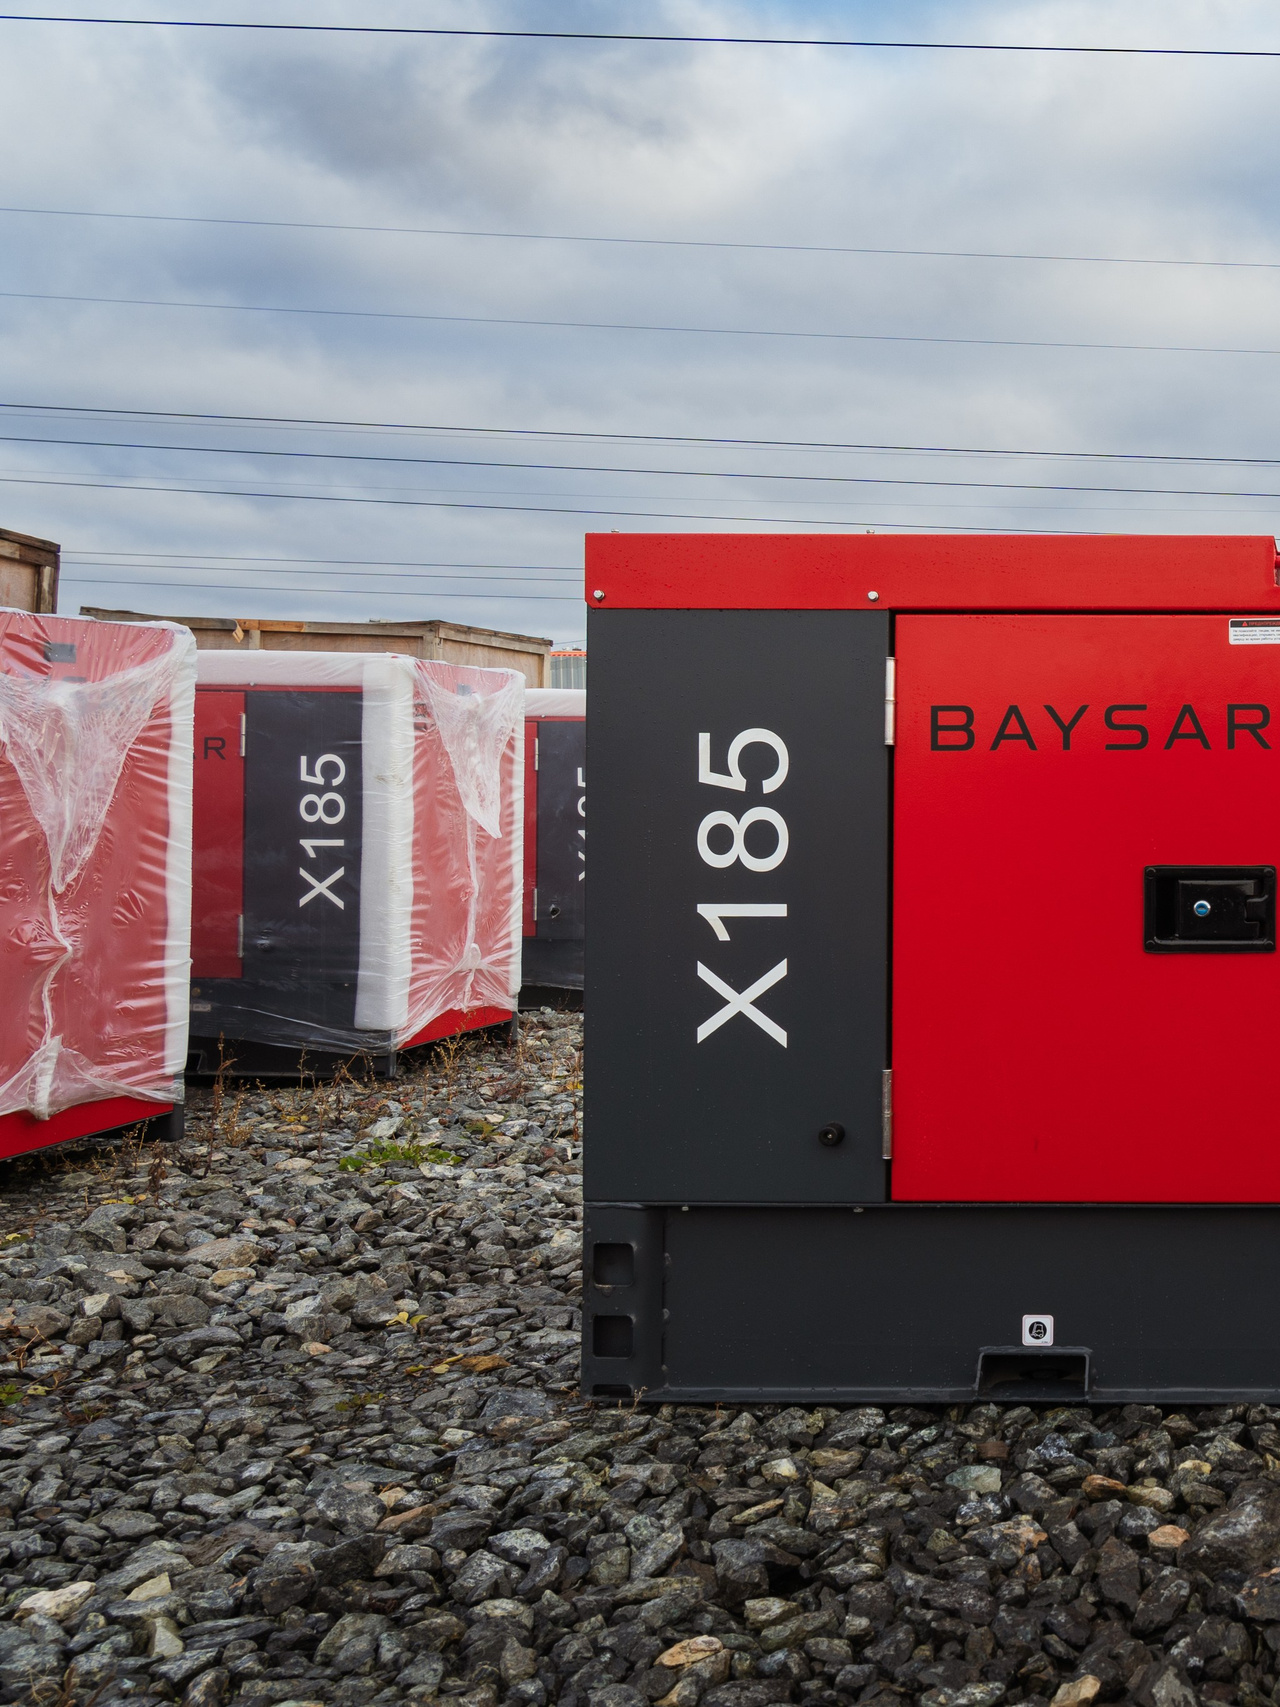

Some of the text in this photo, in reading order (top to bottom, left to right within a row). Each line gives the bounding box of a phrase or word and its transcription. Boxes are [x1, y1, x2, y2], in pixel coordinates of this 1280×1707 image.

[931, 704, 1271, 752] BAYSAR
[299, 754, 346, 910] X185
[697, 728, 789, 1048] X185
